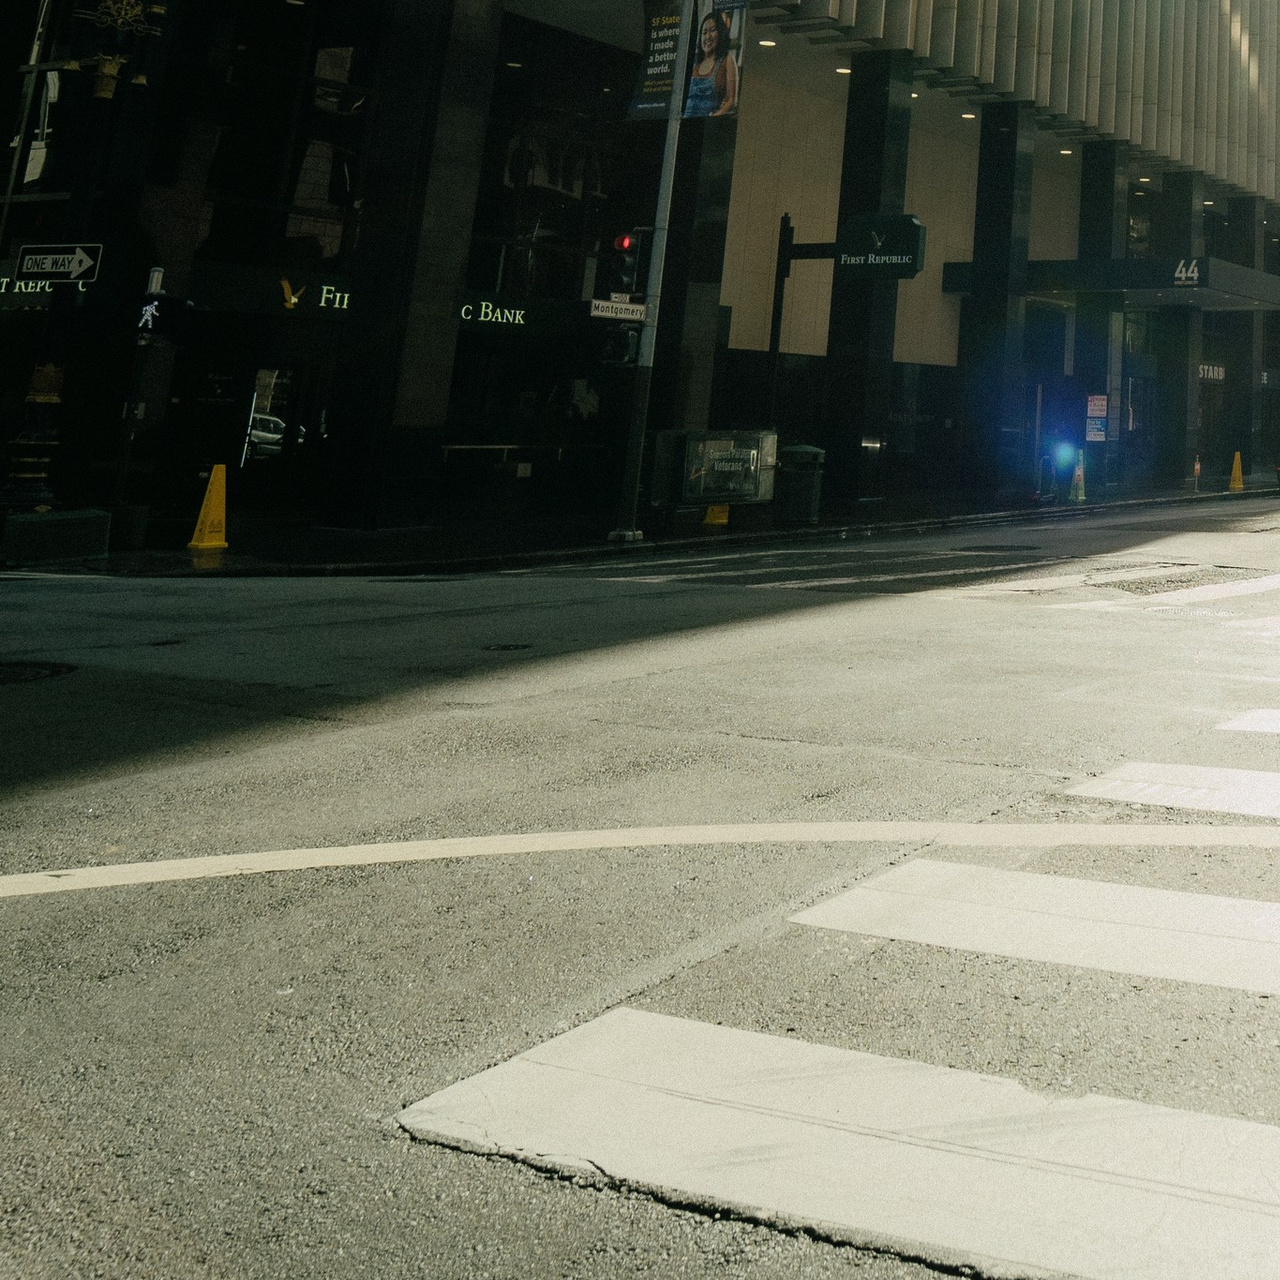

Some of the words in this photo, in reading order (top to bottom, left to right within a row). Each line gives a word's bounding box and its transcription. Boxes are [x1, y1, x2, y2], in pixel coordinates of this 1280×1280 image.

[662, 15, 681, 25] State
[651, 29, 658, 39] is
[659, 27, 680, 38] where
[654, 39, 674, 50] made
[648, 55, 654, 63] a
[655, 51, 677, 62] better
[647, 64, 670, 75] world.
[26, 257, 47, 270] ONE
[51, 256, 74, 270] WAY
[841, 254, 866, 265] FIRST
[867, 253, 913, 264] REPUBLIC
[1174, 259, 1199, 281] 44
[478, 301, 526, 325] BANK
[593, 302, 644, 319] Montgomery
[714, 461, 742, 471] Veterans
